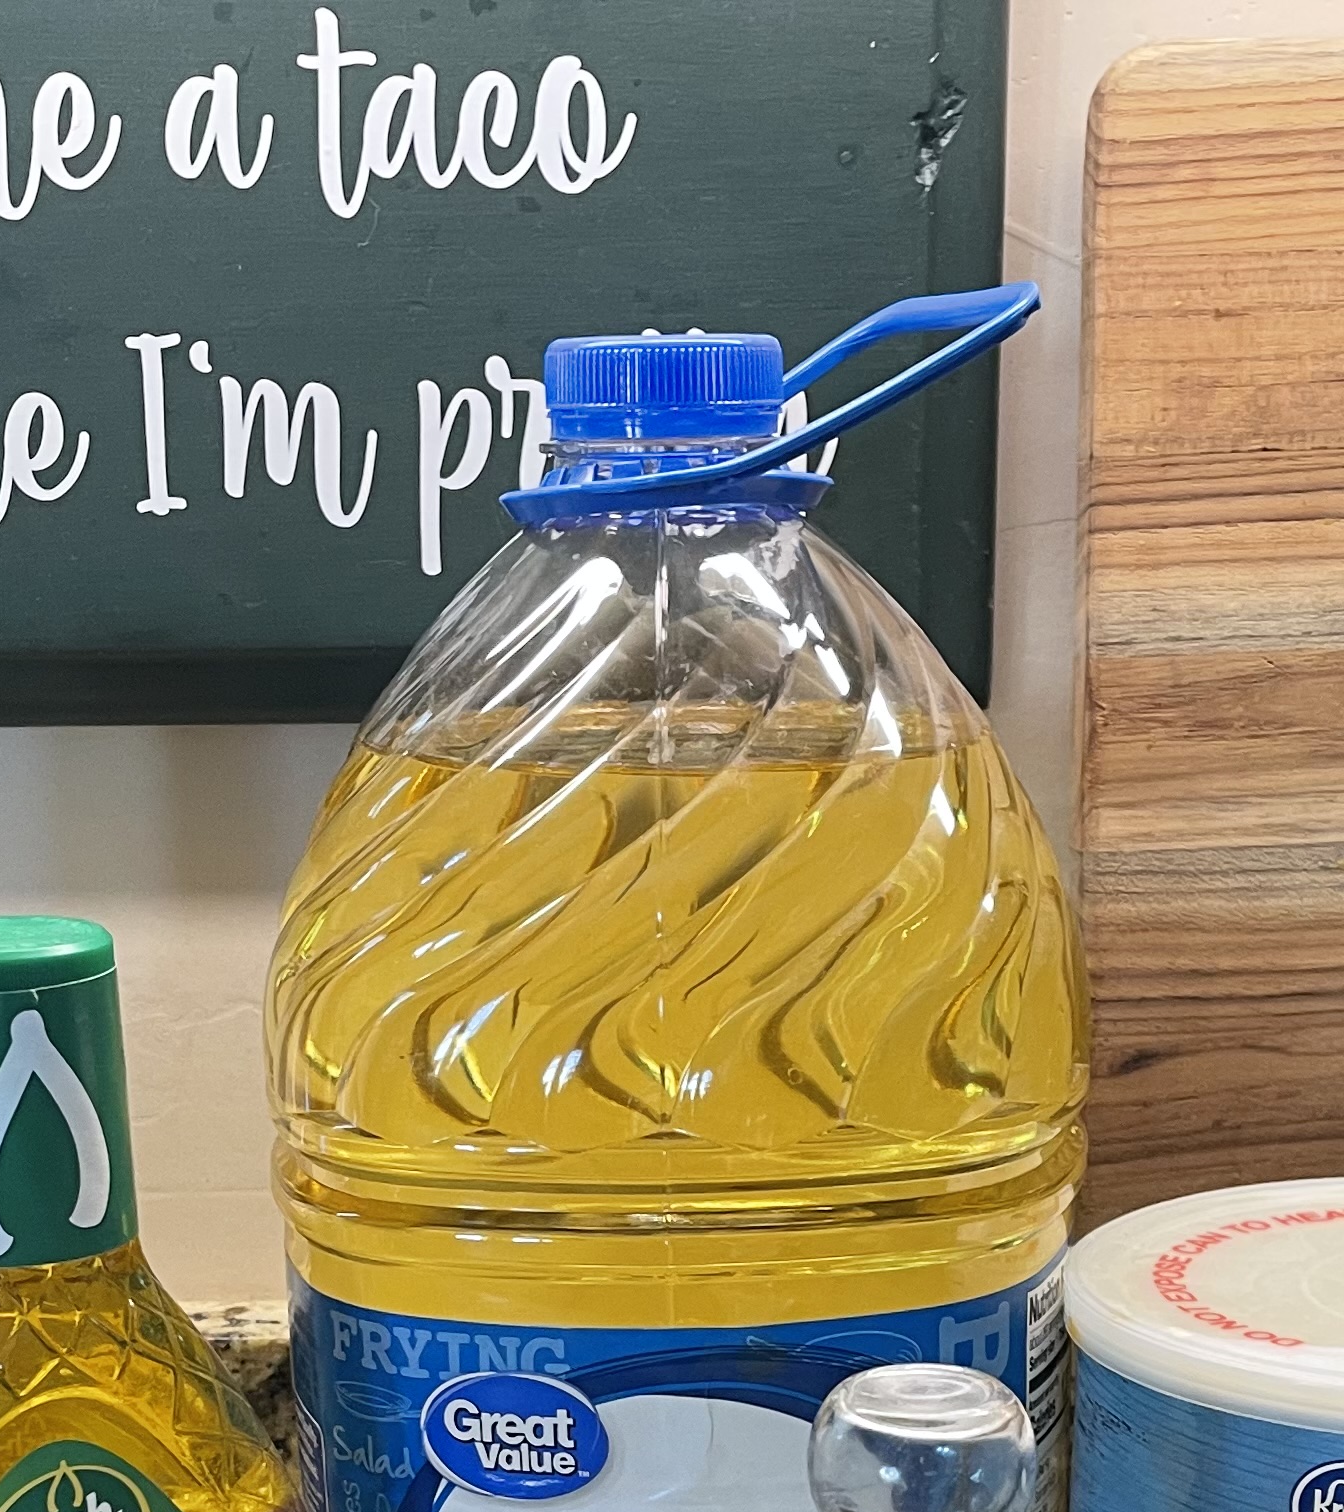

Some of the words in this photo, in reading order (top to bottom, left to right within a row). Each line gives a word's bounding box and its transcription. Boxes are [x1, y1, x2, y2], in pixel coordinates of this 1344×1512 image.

[165, 62, 273, 187] a
[297, 6, 638, 220] taco
[123, 331, 380, 530] I'm
[1172, 1231, 1232, 1256] CAN
[1219, 1219, 1271, 1235] TO
[1153, 1254, 1198, 1302] EXPOSE
[1177, 1303, 1248, 1332] NOT
[1242, 1328, 1306, 1347] DO
[331, 1310, 571, 1380] FRYING
[443, 1398, 575, 1447] Great
[332, 1425, 416, 1480] Salad
[475, 1442, 576, 1475] Value
